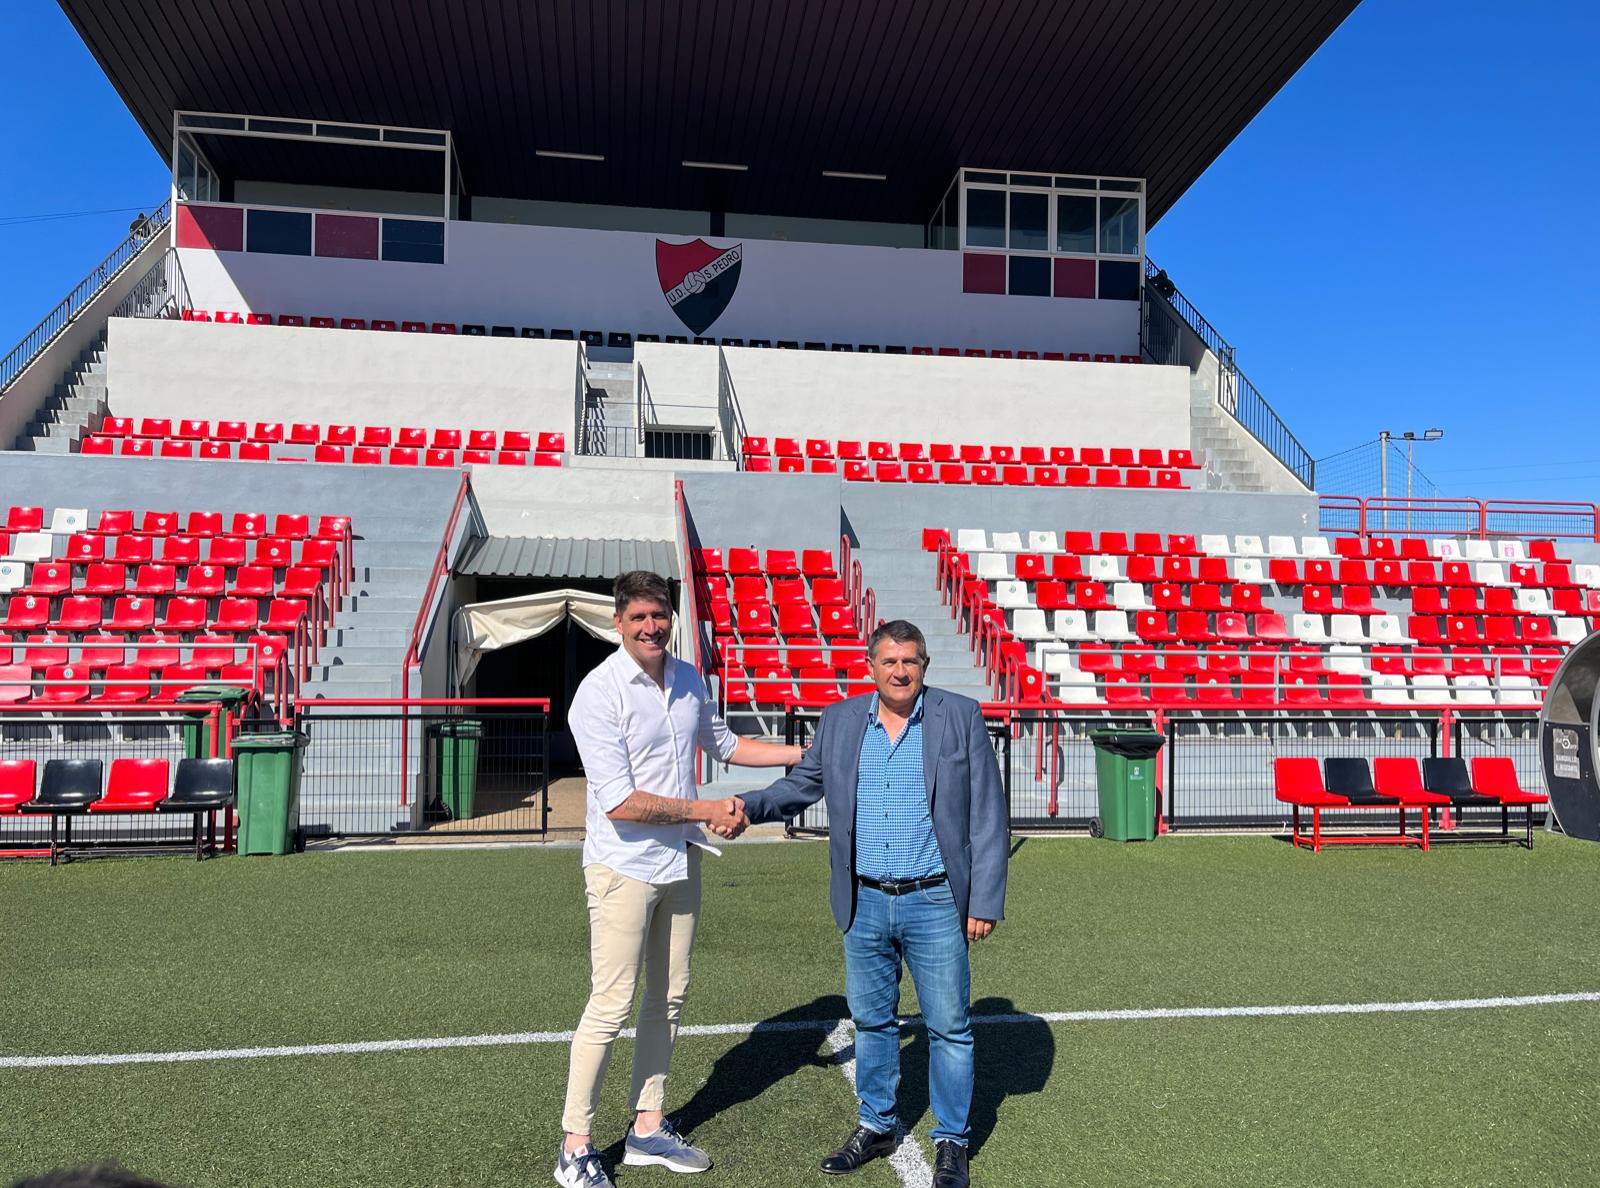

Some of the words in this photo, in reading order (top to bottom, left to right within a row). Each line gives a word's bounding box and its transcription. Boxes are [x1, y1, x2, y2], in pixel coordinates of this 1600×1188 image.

[667, 288, 686, 303] U.D.
[703, 269, 715, 279] S.
[712, 250, 740, 273] PEDRO
